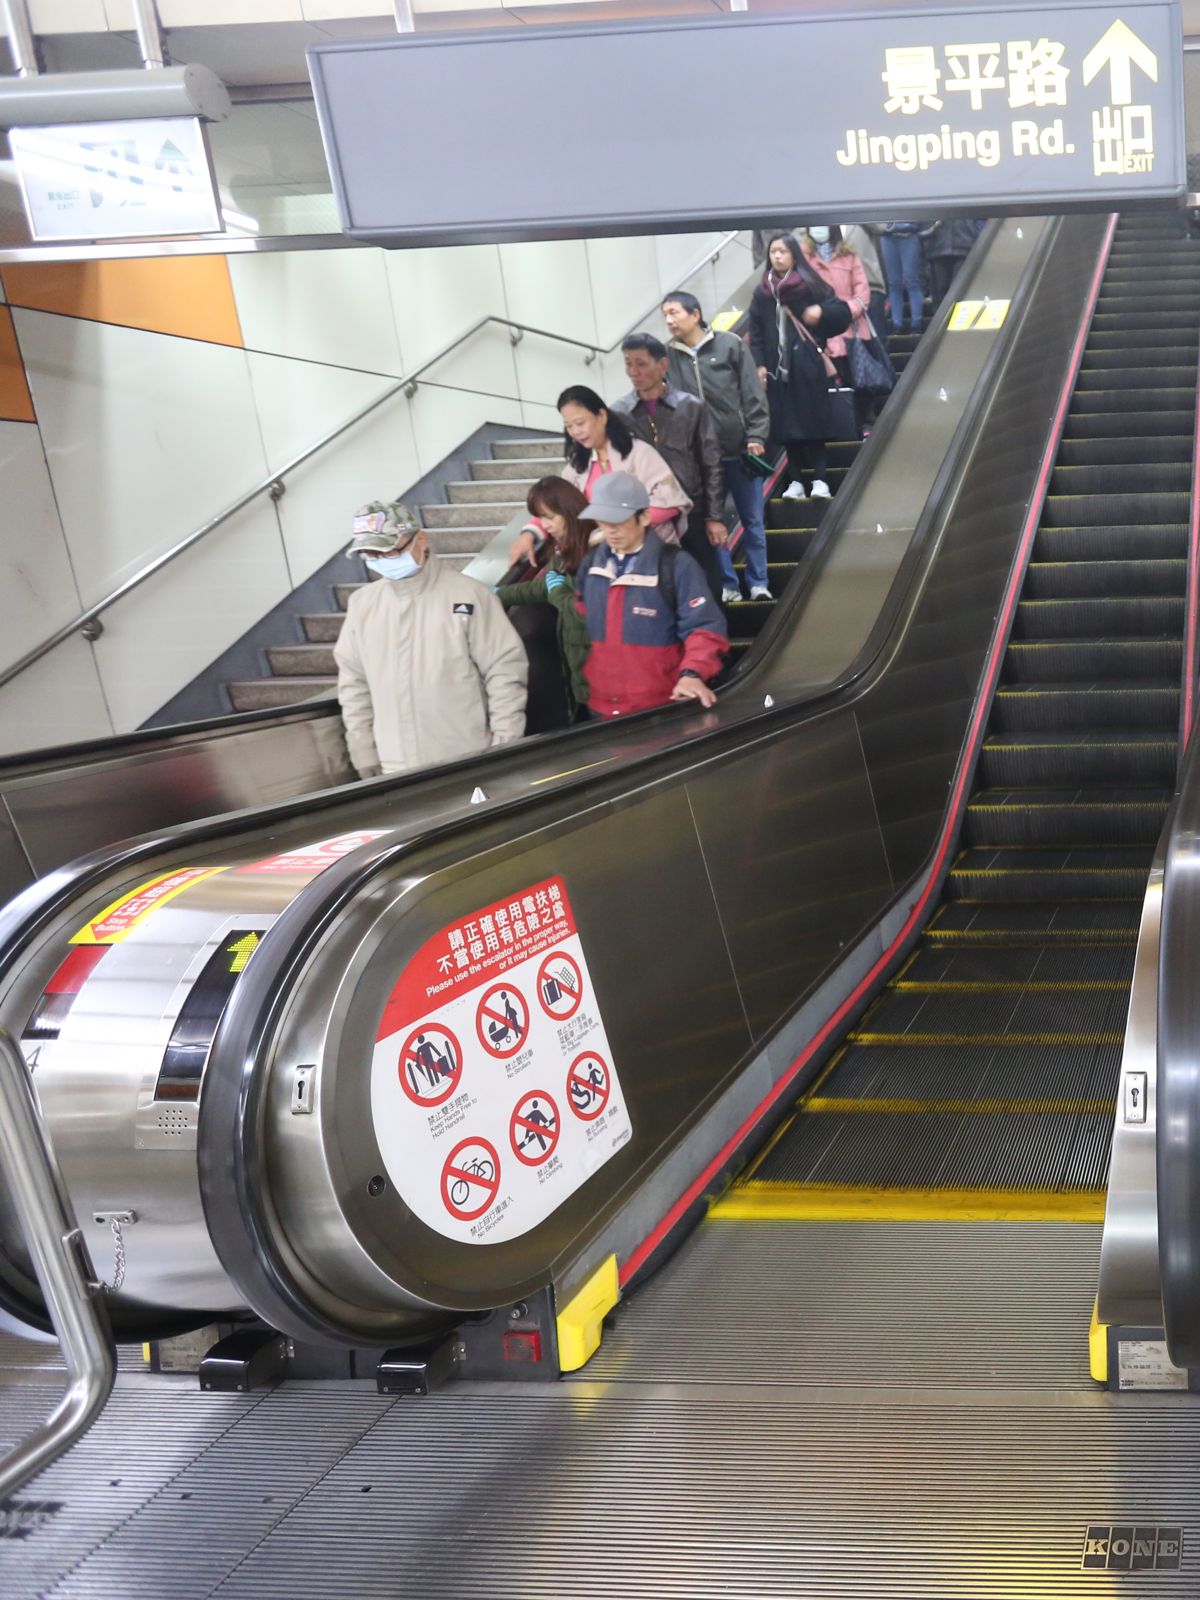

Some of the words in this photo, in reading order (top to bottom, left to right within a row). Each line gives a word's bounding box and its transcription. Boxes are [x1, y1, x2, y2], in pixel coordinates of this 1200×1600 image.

[881, 38, 1071, 115] 景平路
[836, 124, 1001, 171] Jingping
[1011, 118, 1076, 157] Rd.
[1092, 104, 1154, 177] 出口
[1123, 153, 1154, 174] EXIT
[436, 900, 566, 975] 不當使用有危險之虞
[447, 883, 562, 951] 請正確使用電扶梯
[426, 978, 454, 998] Please
[454, 970, 469, 983] use
[469, 963, 482, 976] the
[482, 947, 514, 968] escalator
[521, 934, 534, 948] the
[533, 926, 555, 943] proper
[513, 949, 529, 964] may
[528, 941, 548, 953] cause
[1086, 1538, 1180, 1556] KONE
